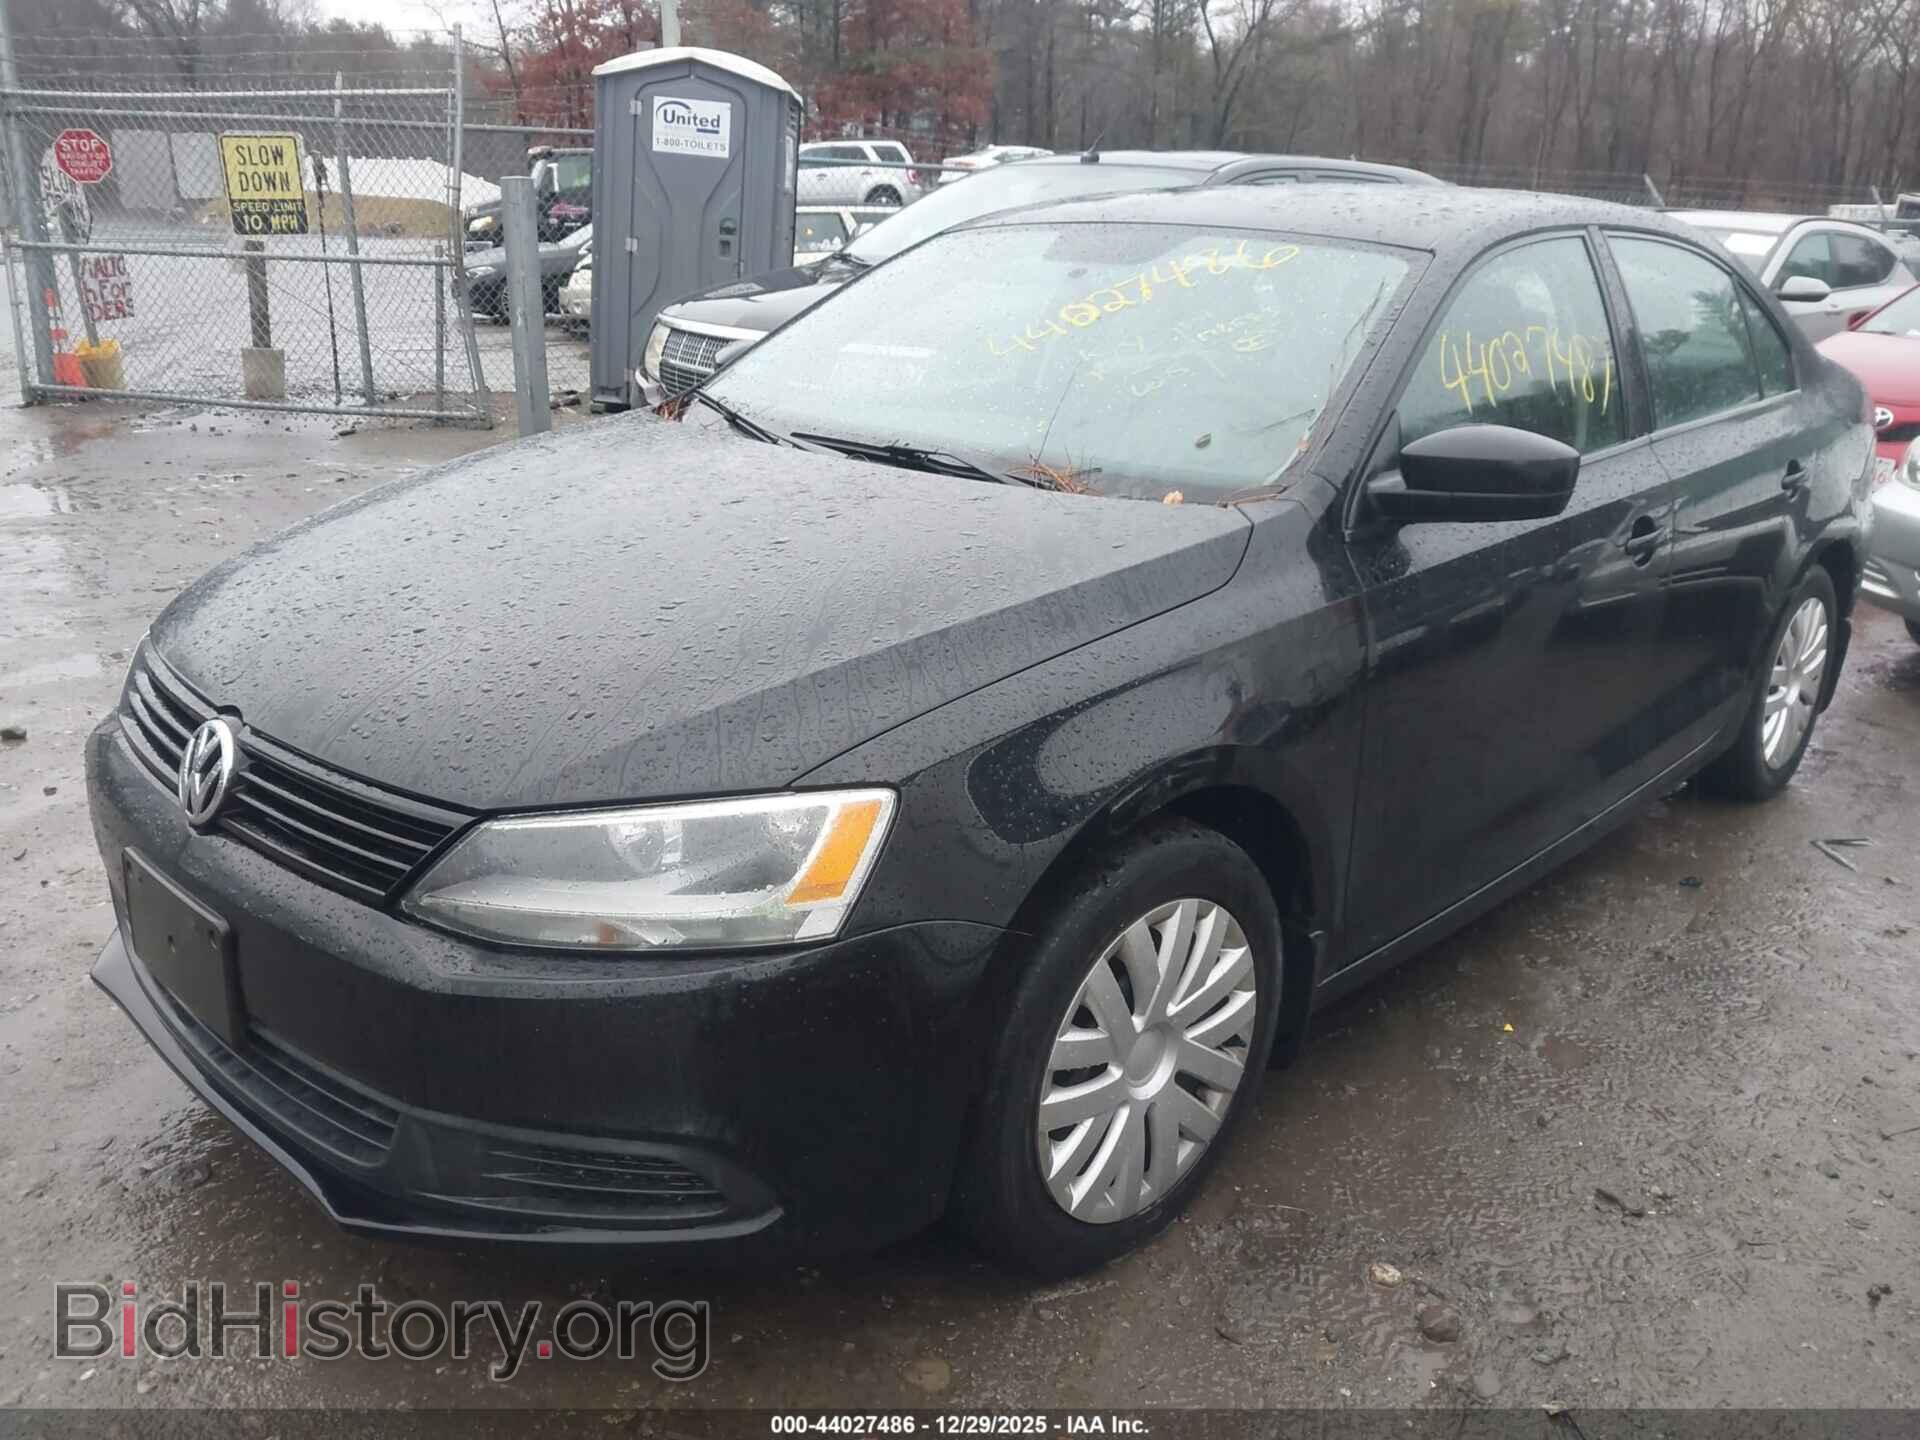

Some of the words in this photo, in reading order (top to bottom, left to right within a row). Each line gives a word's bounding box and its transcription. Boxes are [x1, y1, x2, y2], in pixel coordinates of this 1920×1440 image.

[663, 109, 720, 128] United
[60, 139, 101, 152] STOP
[656, 137, 726, 152] 1-800-TOILETS
[235, 144, 284, 167] SLOW
[238, 171, 291, 192] DOWN
[232, 201, 270, 212] SPEED
[243, 214, 263, 231] 10
[270, 214, 299, 230] MPH
